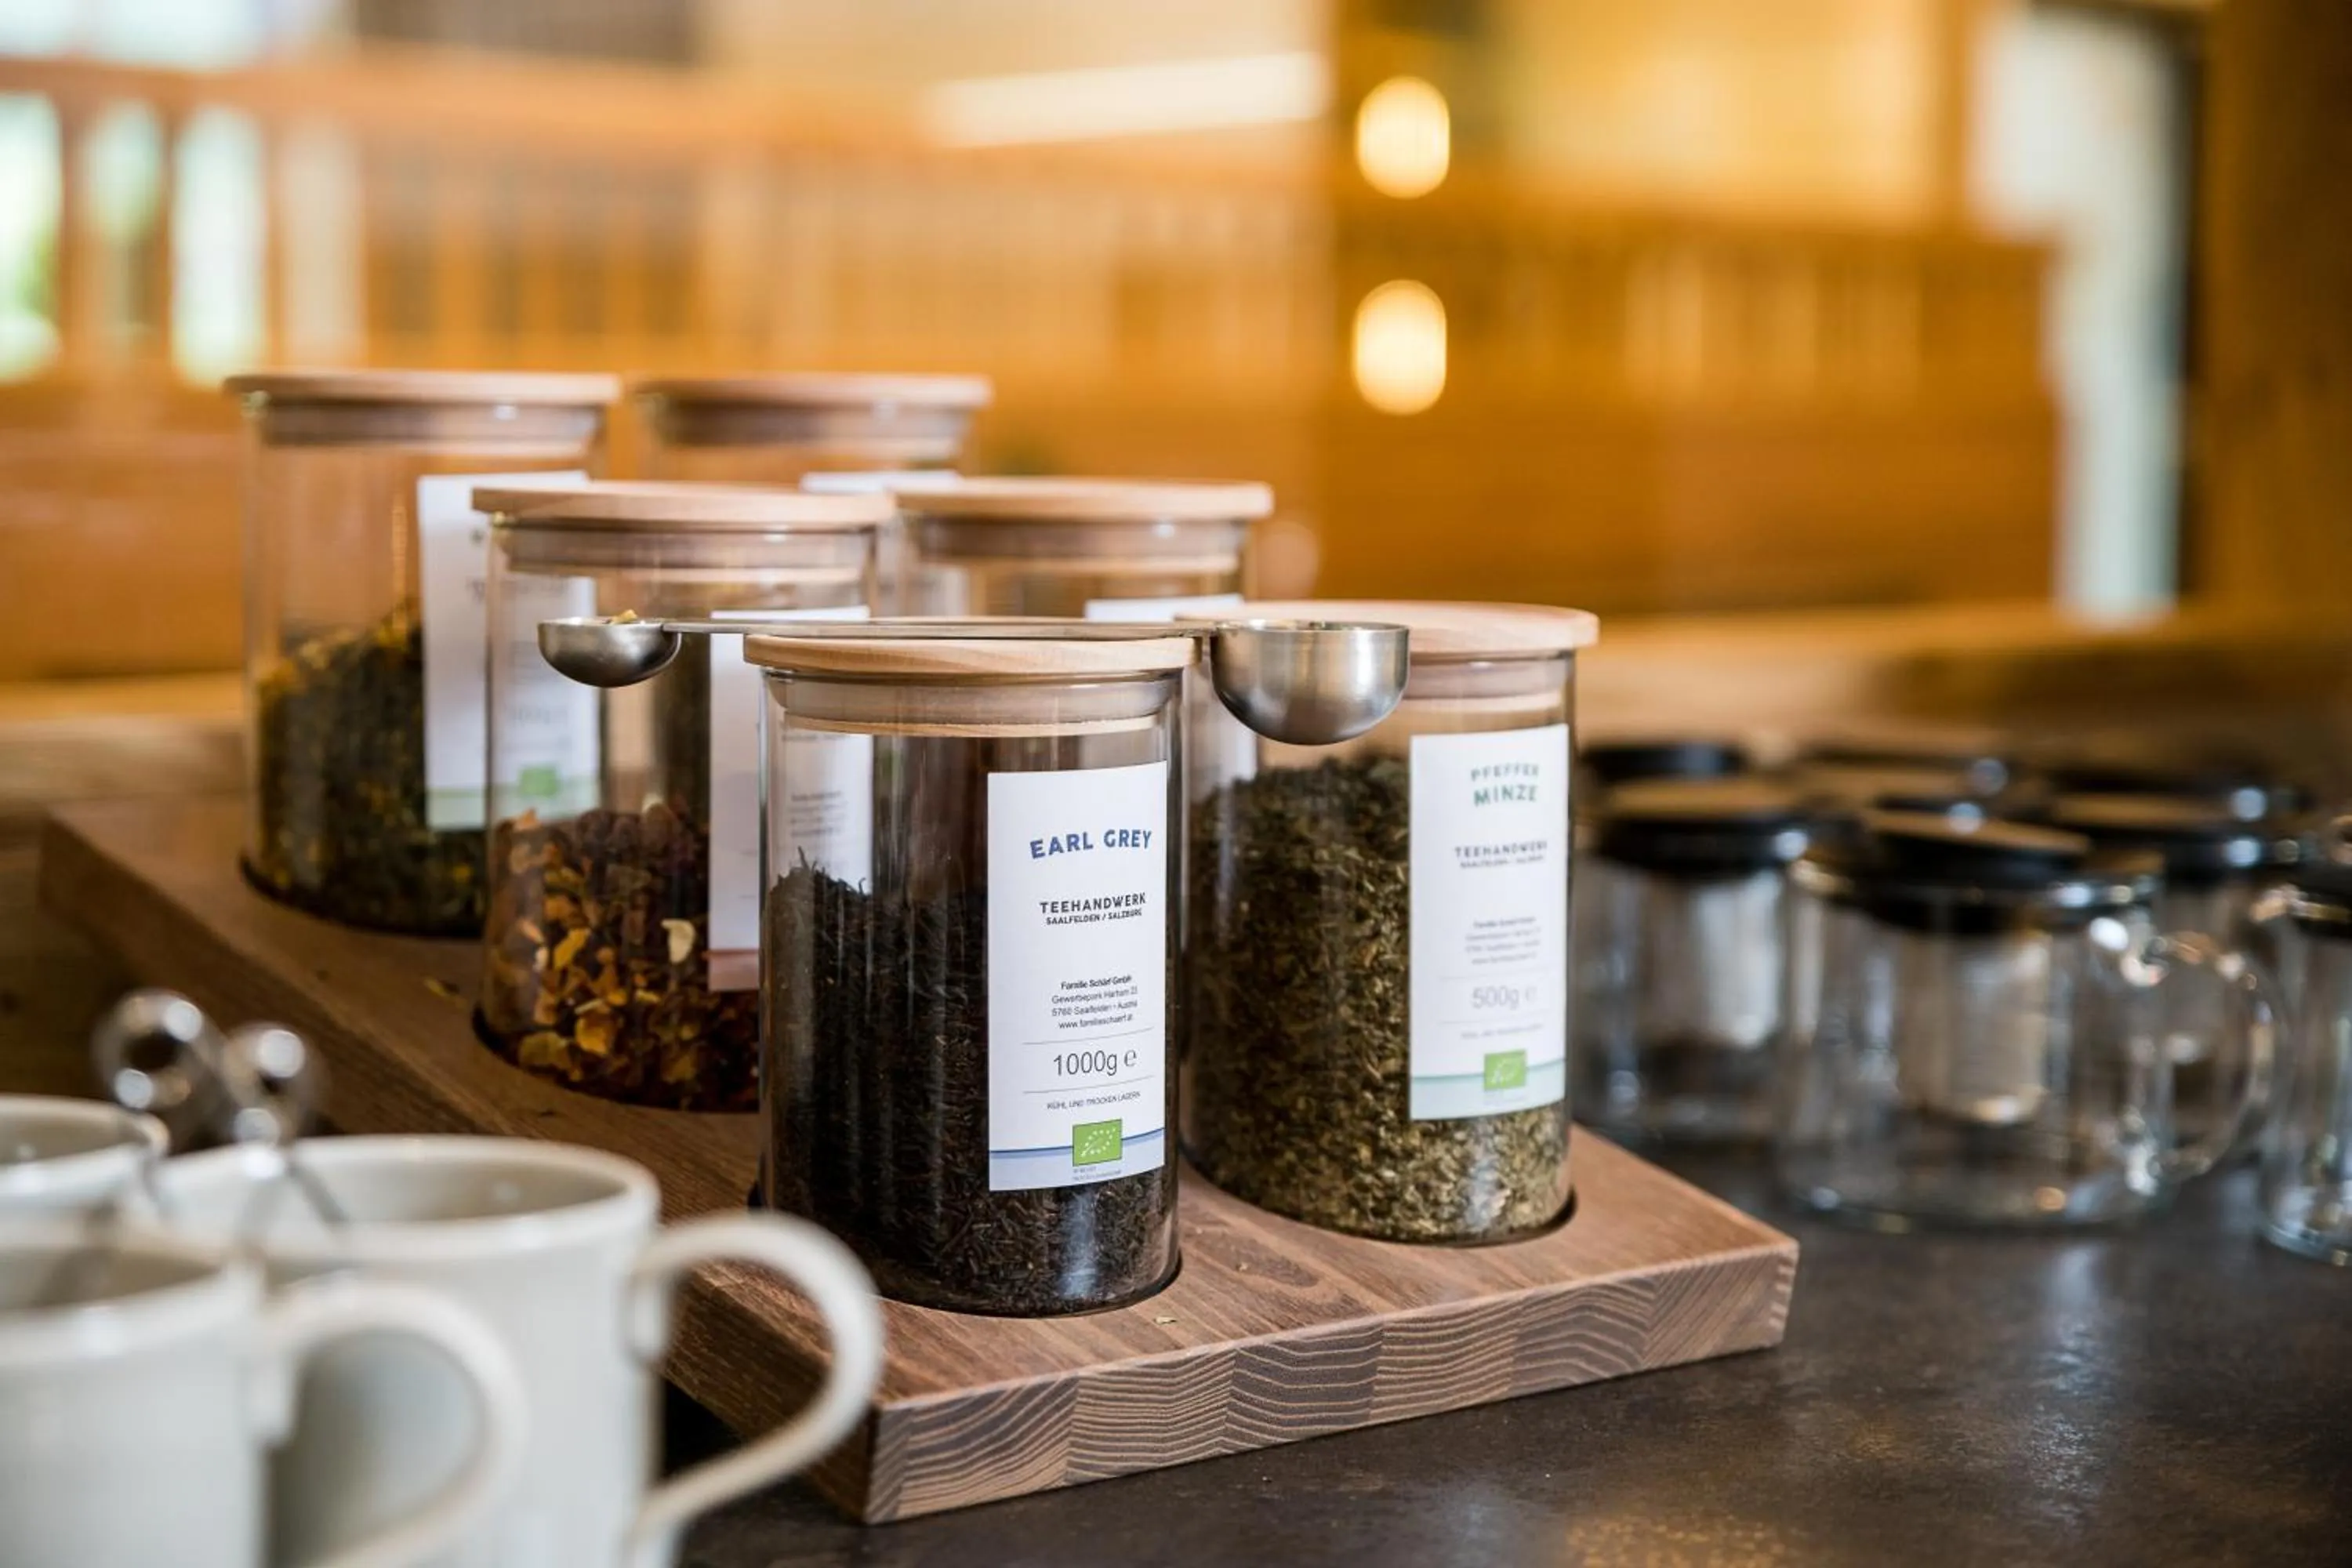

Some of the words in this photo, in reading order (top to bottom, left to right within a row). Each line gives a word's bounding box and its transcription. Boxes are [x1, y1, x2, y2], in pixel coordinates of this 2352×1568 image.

[1474, 784, 1537, 807] MINZE
[1030, 832, 1094, 859] EARL
[1103, 829, 1152, 849] GREY
[1040, 892, 1146, 914] TEEHANDWERK
[1046, 913, 1100, 925] SAALFELDEN
[1108, 908, 1142, 920] SALZBURG
[1061, 980, 1088, 990] Familie
[1471, 985, 1520, 1011] 500g
[1054, 1050, 1117, 1076] 1000g
